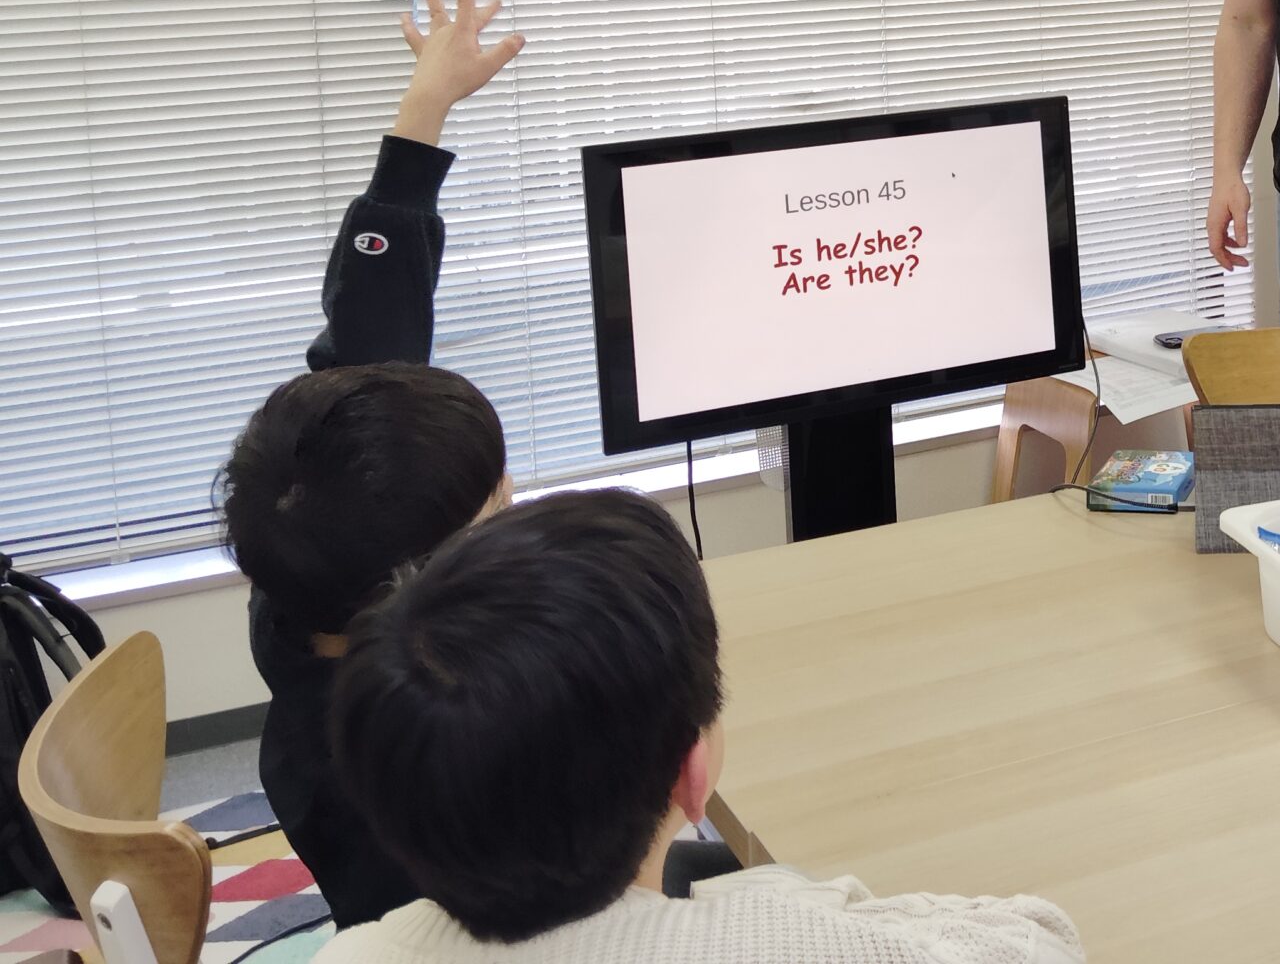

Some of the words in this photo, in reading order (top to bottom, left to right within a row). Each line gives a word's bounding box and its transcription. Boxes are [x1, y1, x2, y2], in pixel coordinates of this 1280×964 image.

[784, 188, 870, 214] Lesson
[877, 179, 906, 201] 45
[771, 244, 803, 269] Is
[815, 225, 923, 262] he/she?
[781, 271, 832, 296] Are
[844, 253, 920, 287] they?
